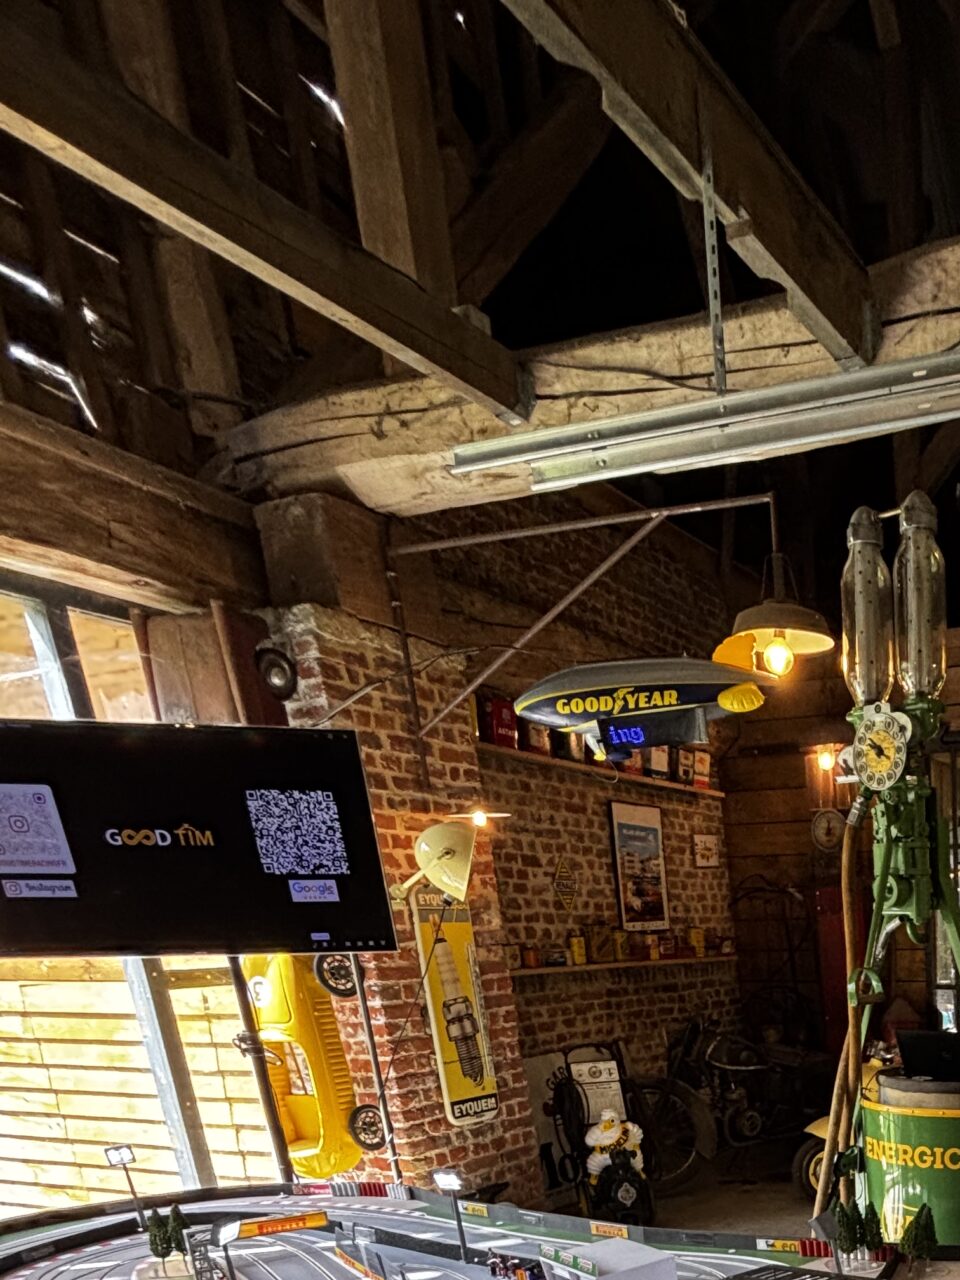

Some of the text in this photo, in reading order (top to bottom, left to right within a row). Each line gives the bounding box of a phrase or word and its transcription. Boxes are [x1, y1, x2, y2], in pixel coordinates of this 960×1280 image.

[608, 725, 645, 745] ing
[105, 828, 172, 847] GOOD
[291, 881, 334, 897] Google
[417, 893, 444, 906] EYQU
[453, 1097, 497, 1118] EYQUEM
